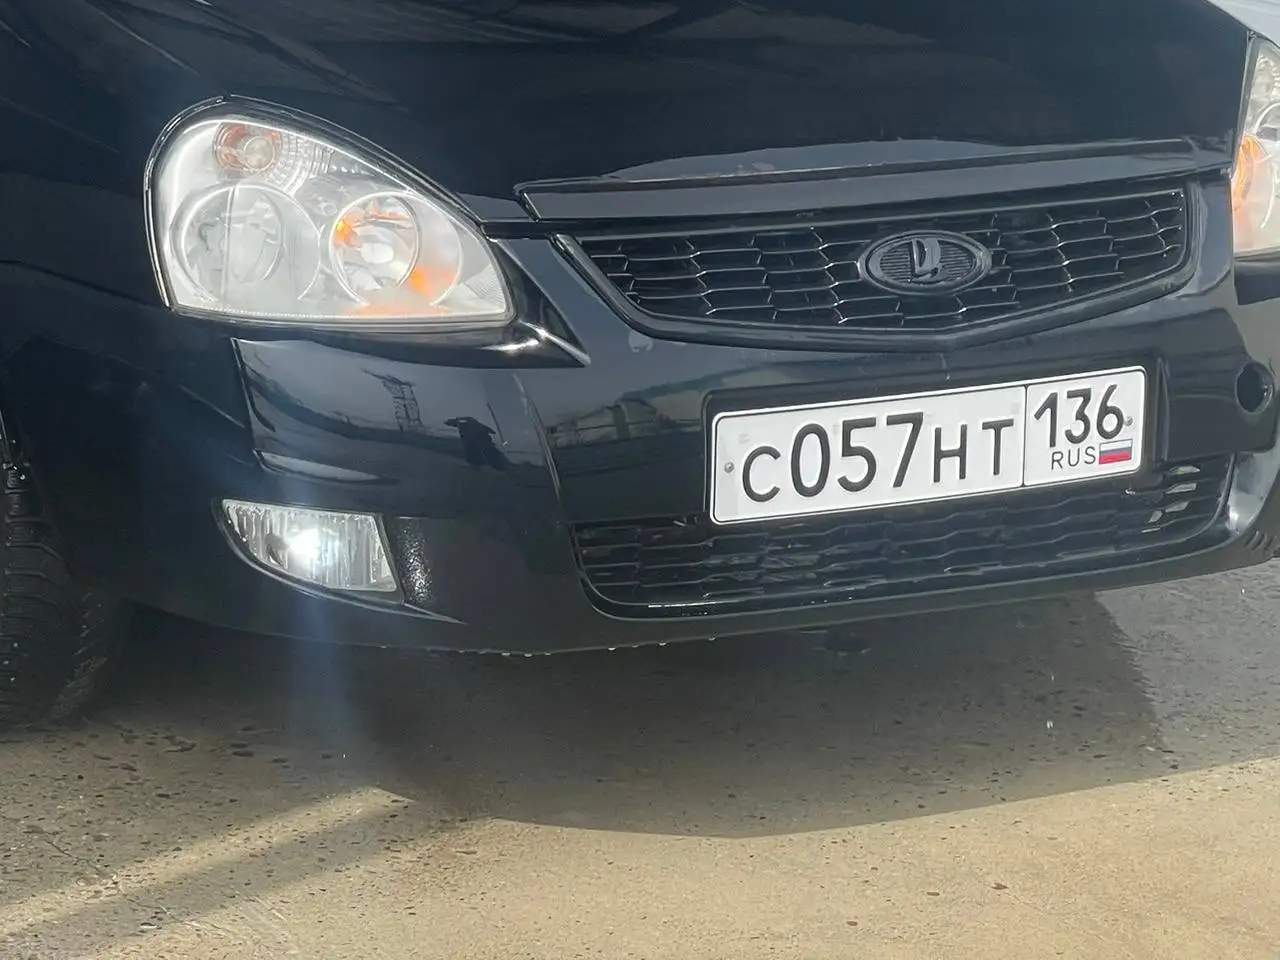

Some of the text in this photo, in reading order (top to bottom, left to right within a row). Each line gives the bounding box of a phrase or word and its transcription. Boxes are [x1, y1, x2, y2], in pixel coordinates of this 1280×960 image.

[741, 384, 1125, 502] С057НТ 136
[1051, 446, 1096, 471] RUS
